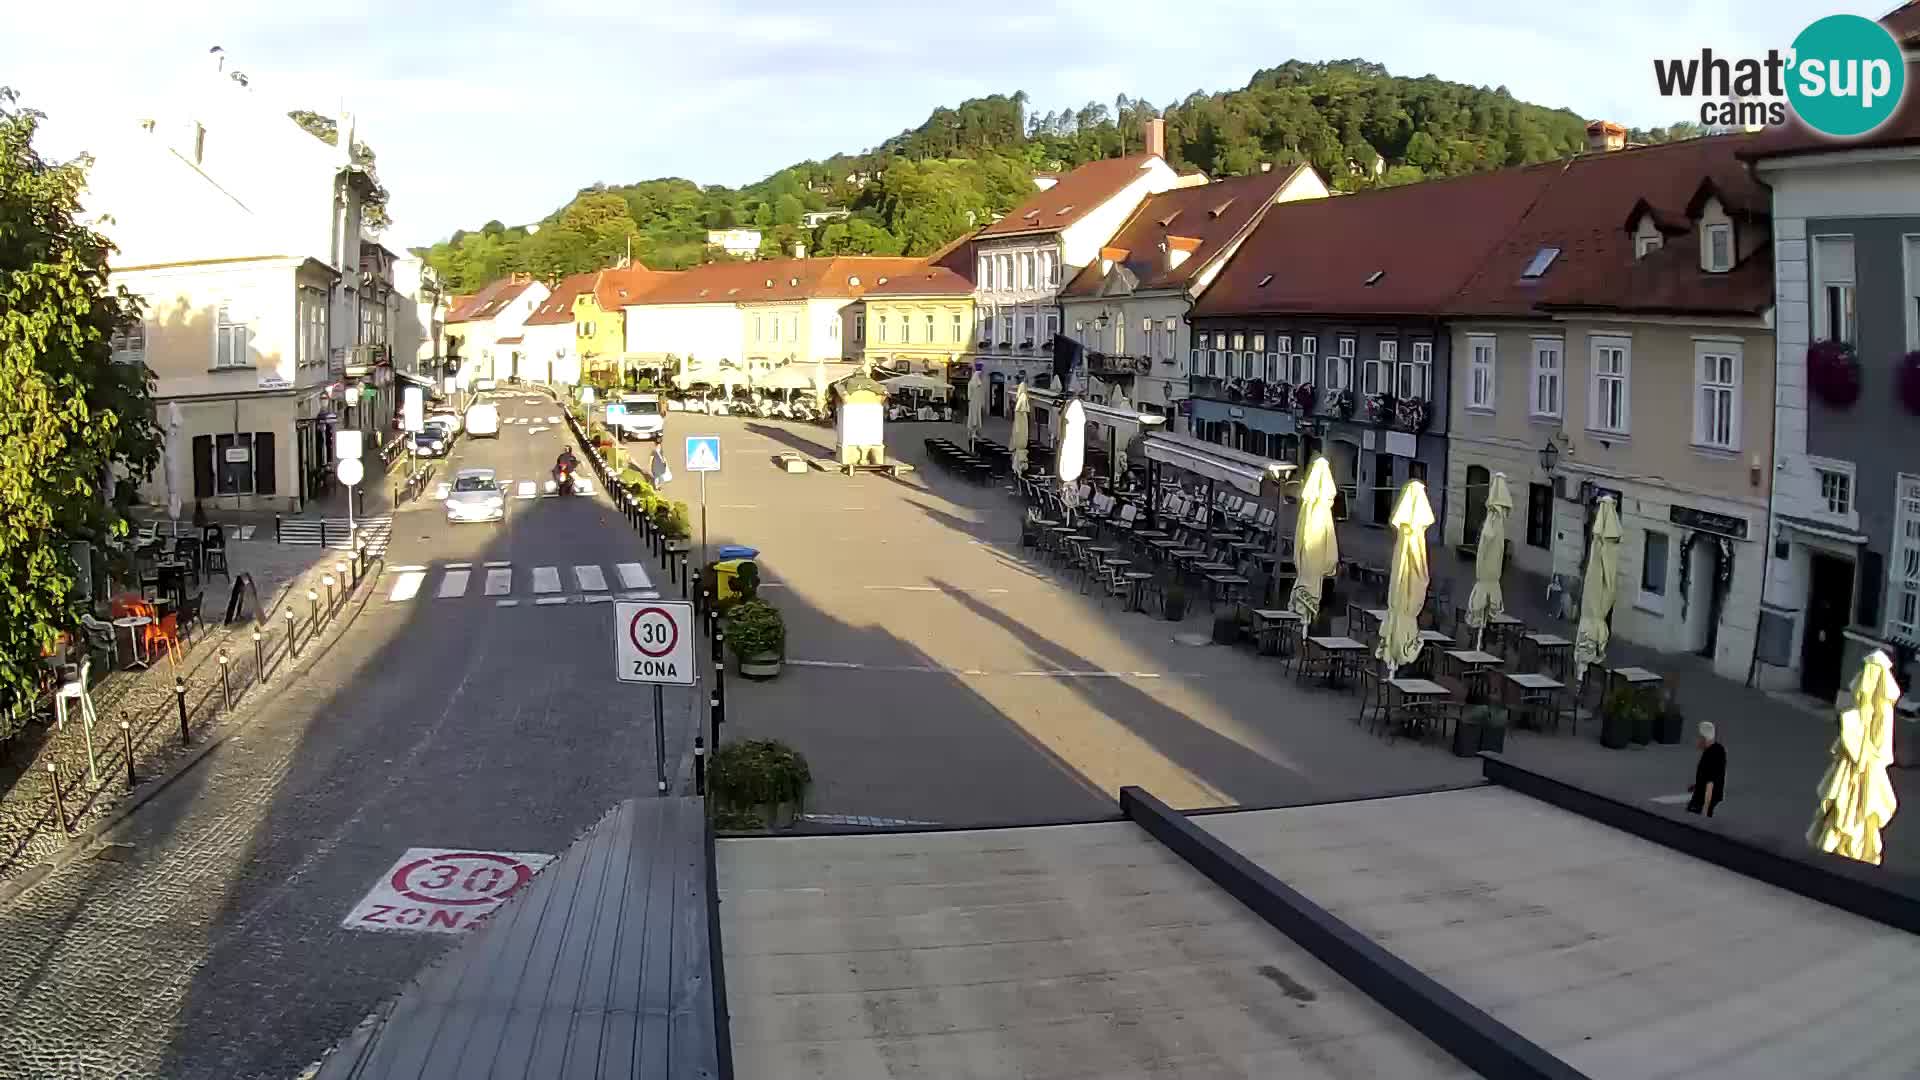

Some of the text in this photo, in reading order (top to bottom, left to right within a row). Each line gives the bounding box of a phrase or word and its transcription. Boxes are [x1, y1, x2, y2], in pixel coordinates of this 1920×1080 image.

[643, 623, 667, 644] 30
[633, 660, 678, 677] ZONA
[420, 865, 504, 892] 30
